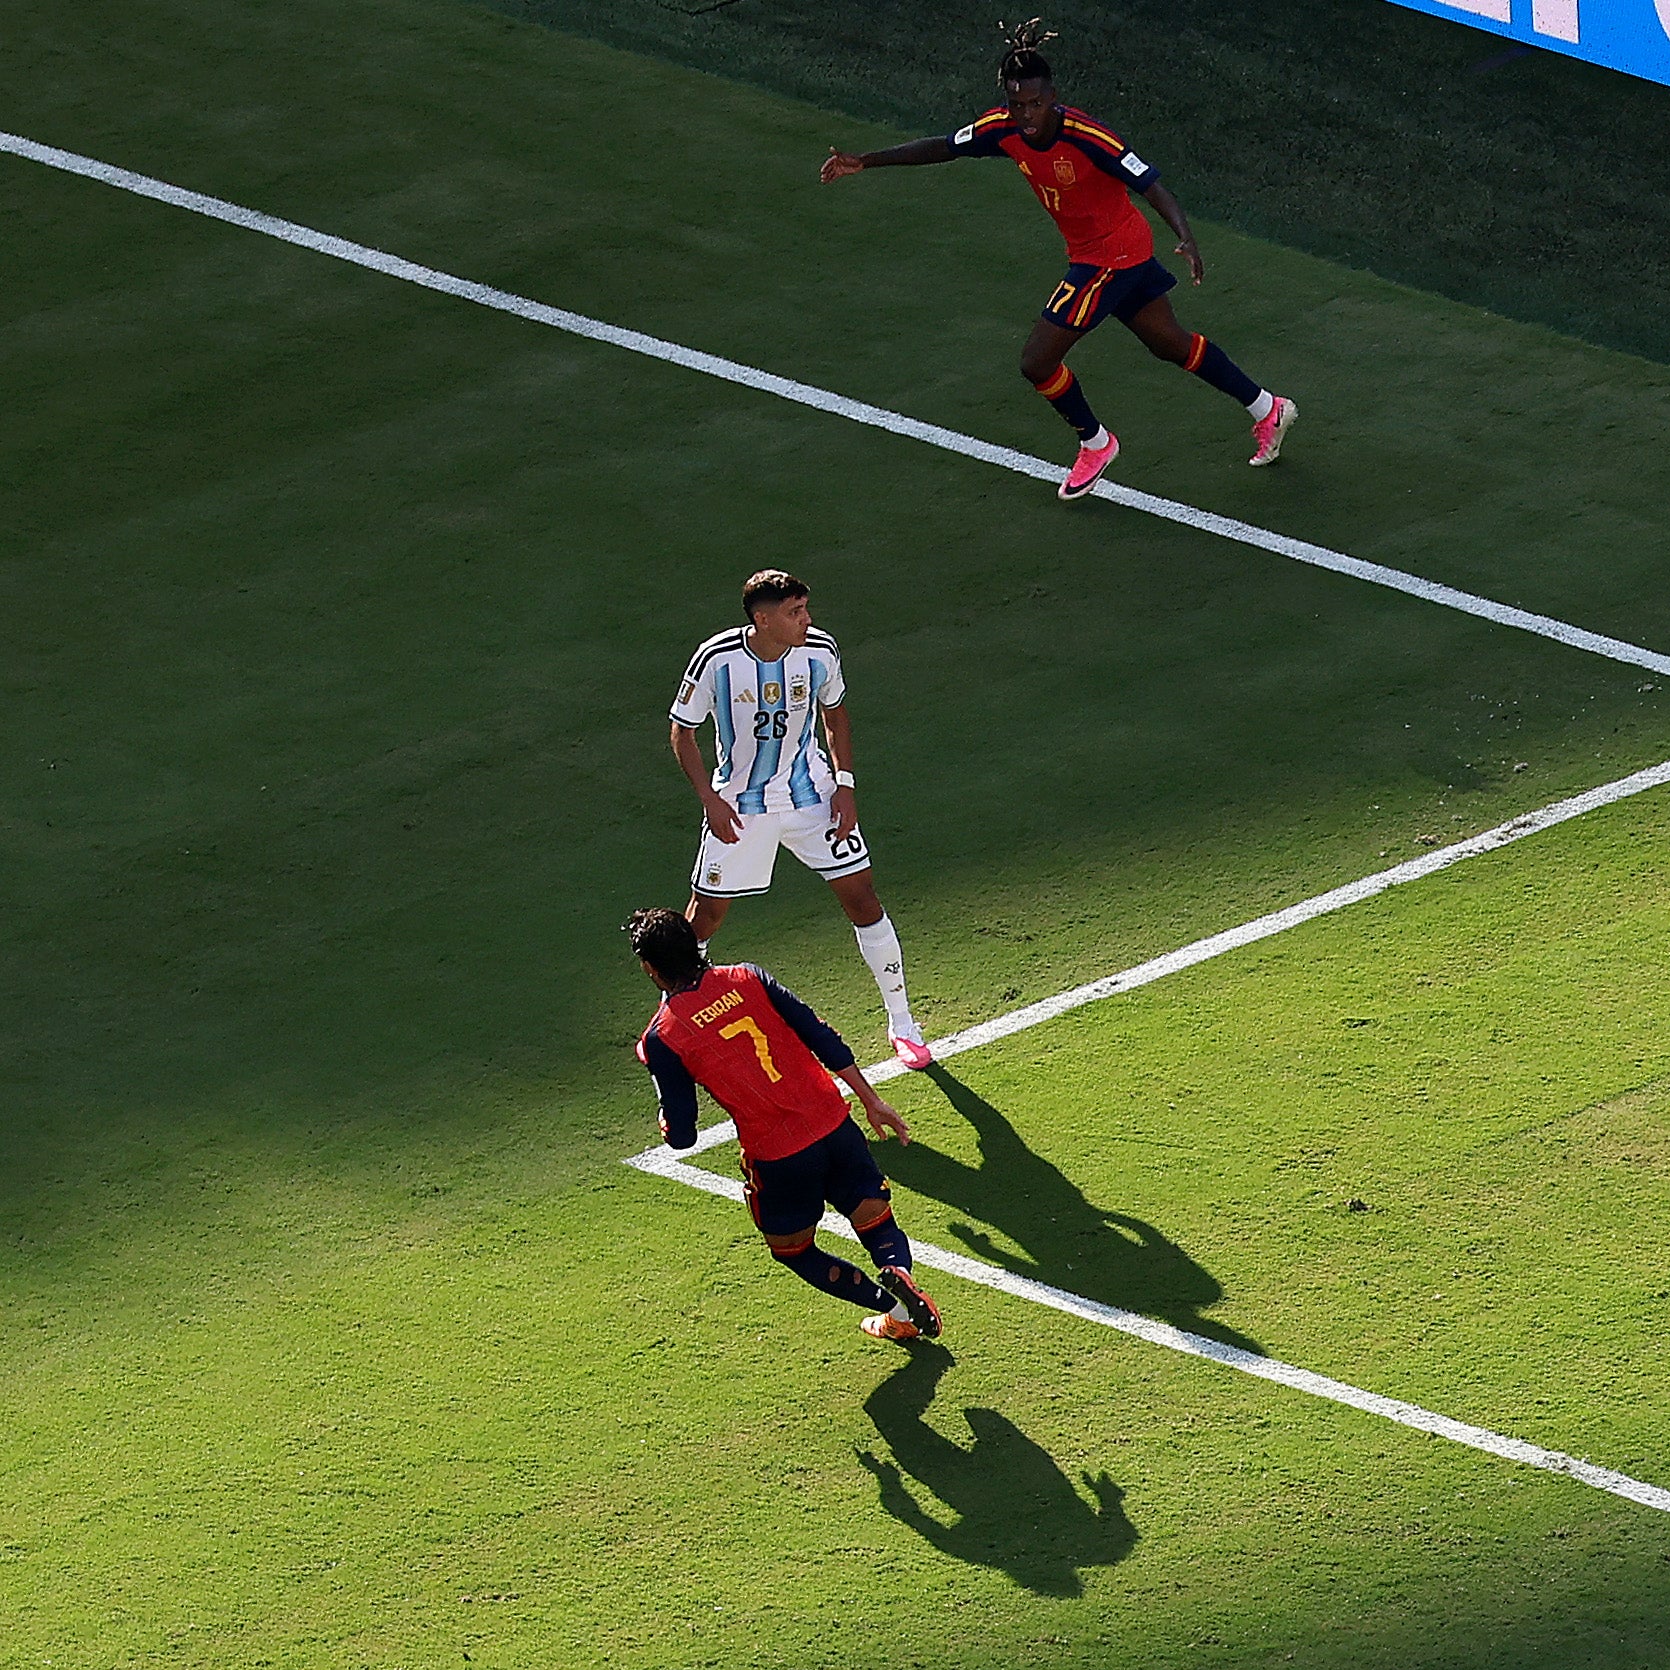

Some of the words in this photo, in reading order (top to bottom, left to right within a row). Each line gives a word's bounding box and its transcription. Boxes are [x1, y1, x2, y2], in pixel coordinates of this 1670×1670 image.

[1038, 183, 1061, 211] 17
[1046, 280, 1077, 313] 17
[753, 709, 789, 741] 26
[690, 988, 745, 1029] FERRAN
[718, 1015, 783, 1084] 7
